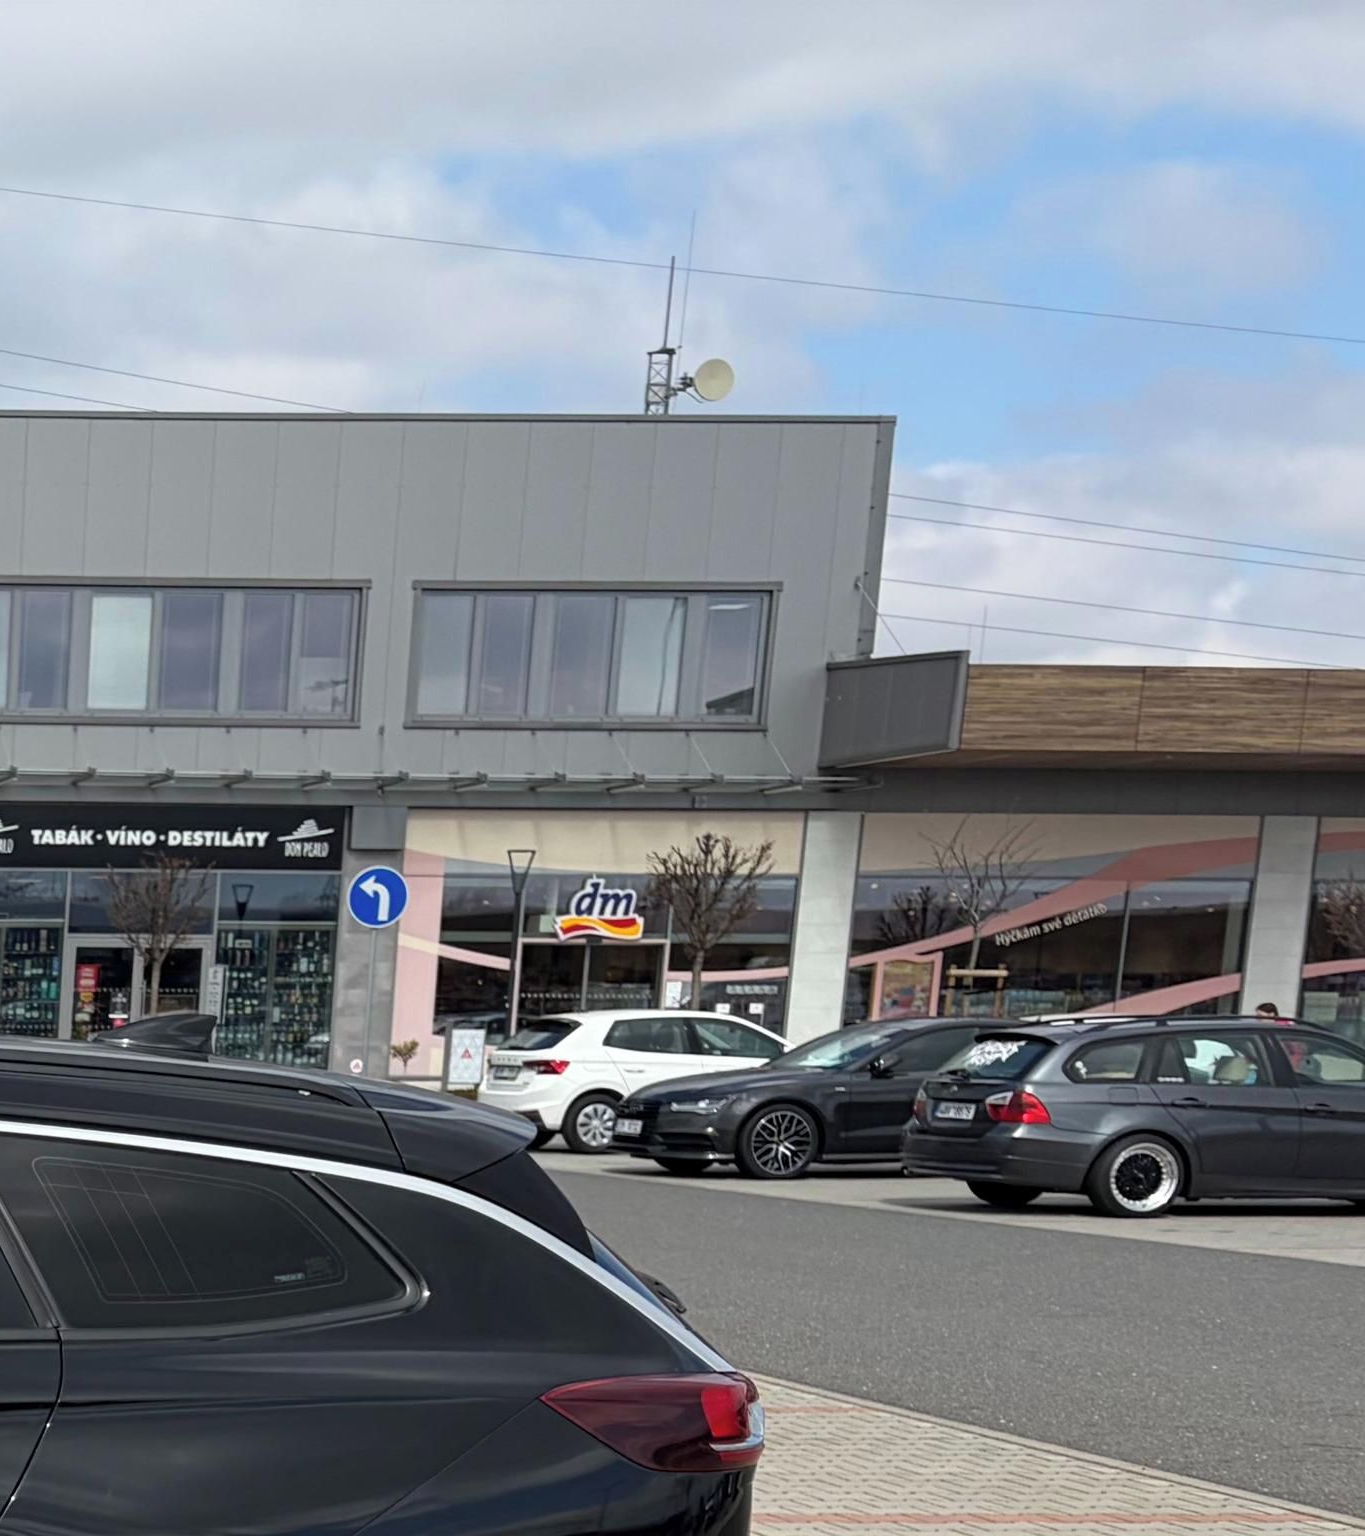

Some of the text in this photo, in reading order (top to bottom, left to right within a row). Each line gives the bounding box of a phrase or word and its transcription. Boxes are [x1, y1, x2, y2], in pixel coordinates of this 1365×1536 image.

[31, 825, 270, 847] TABÁK VÍNO DESTILÁTY
[575, 882, 634, 918] dm
[1042, 917, 1063, 933] své
